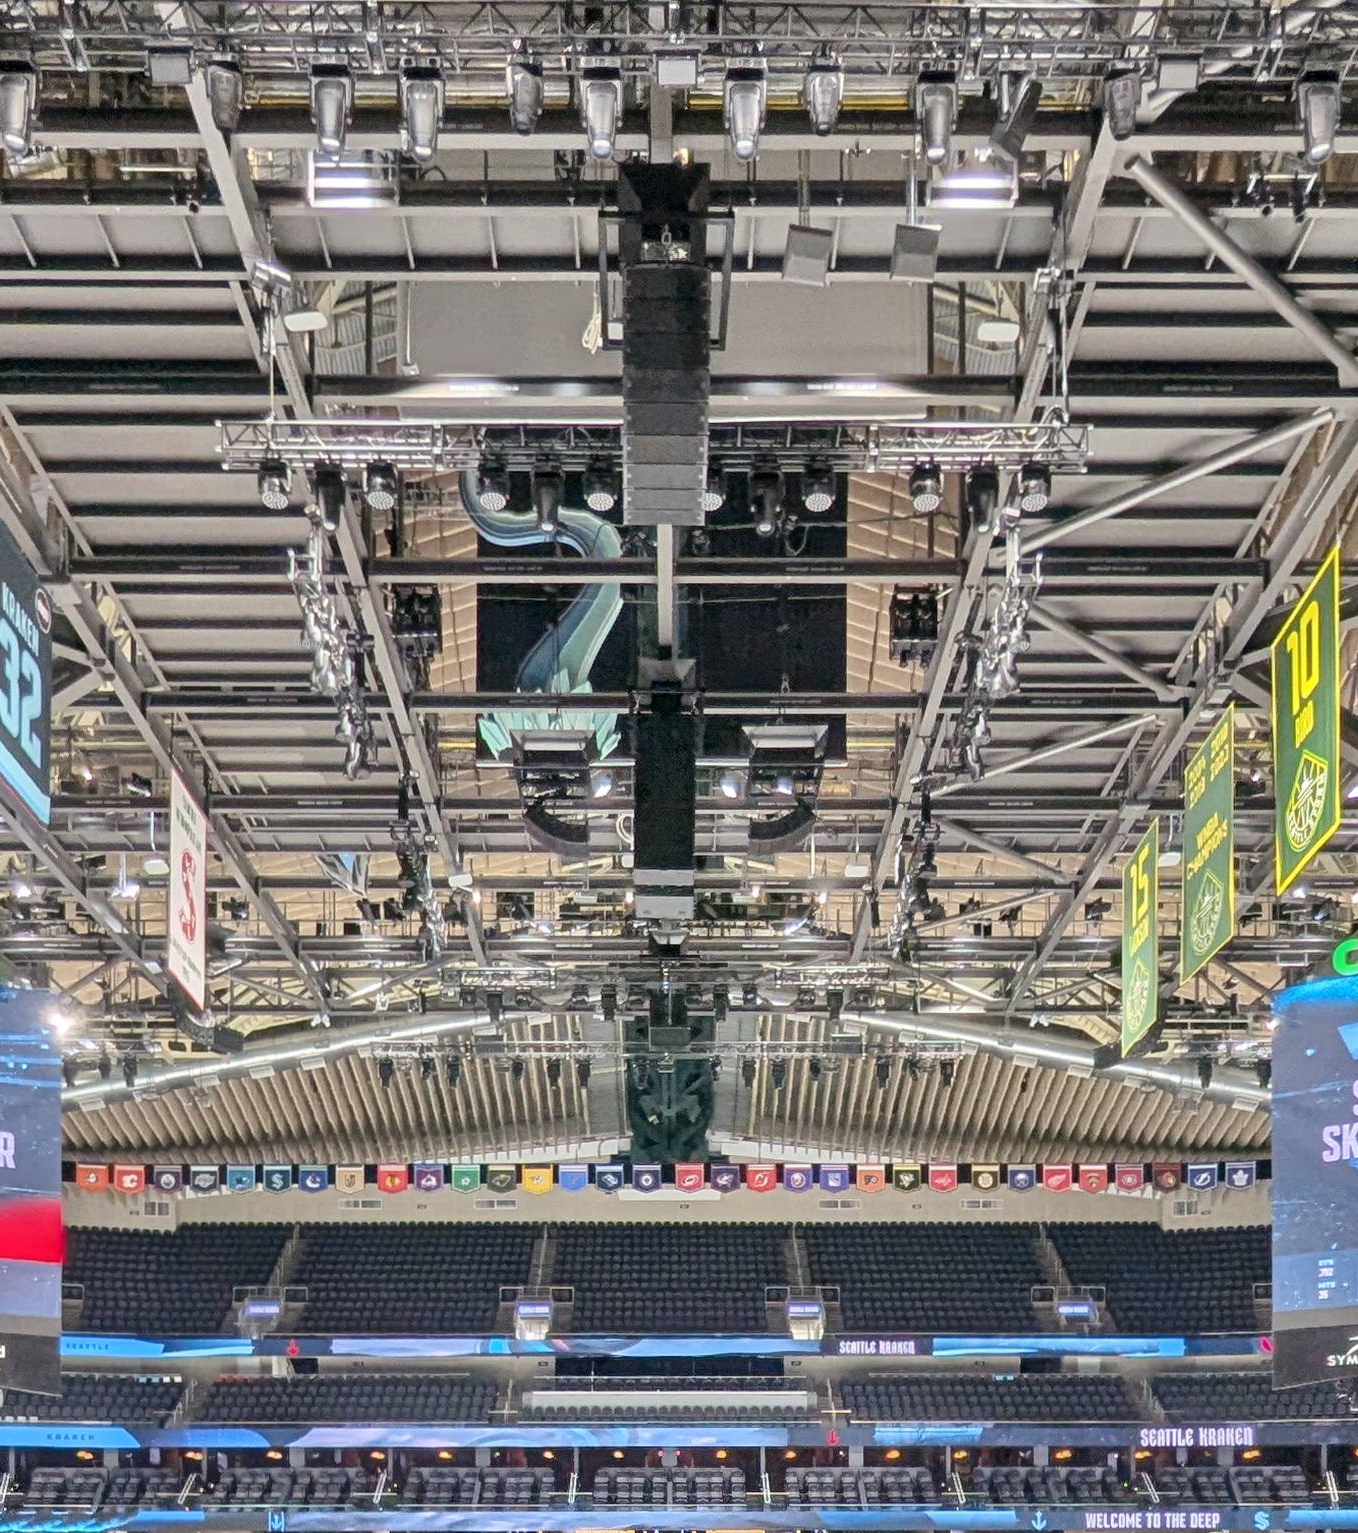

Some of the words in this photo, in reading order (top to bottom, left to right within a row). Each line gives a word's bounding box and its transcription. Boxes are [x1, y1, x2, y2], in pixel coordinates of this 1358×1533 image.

[2, 581, 38, 657] KRAKEN
[1287, 601, 1319, 715] 10
[1130, 843, 1149, 928] 15
[65, 1341, 110, 1351] SEATTLE
[840, 1341, 876, 1354] SEATTLE
[880, 1340, 915, 1354] KRAKEN
[47, 1432, 96, 1442] KRAKEN
[1141, 1428, 1197, 1446] SEATTLE
[1199, 1427, 1254, 1446] KRAKEN
[1085, 1513, 1142, 1529] WELCOME
[1145, 1513, 1160, 1529] TO
[1164, 1513, 1186, 1529] THE
[1189, 1513, 1220, 1529] DEEP
